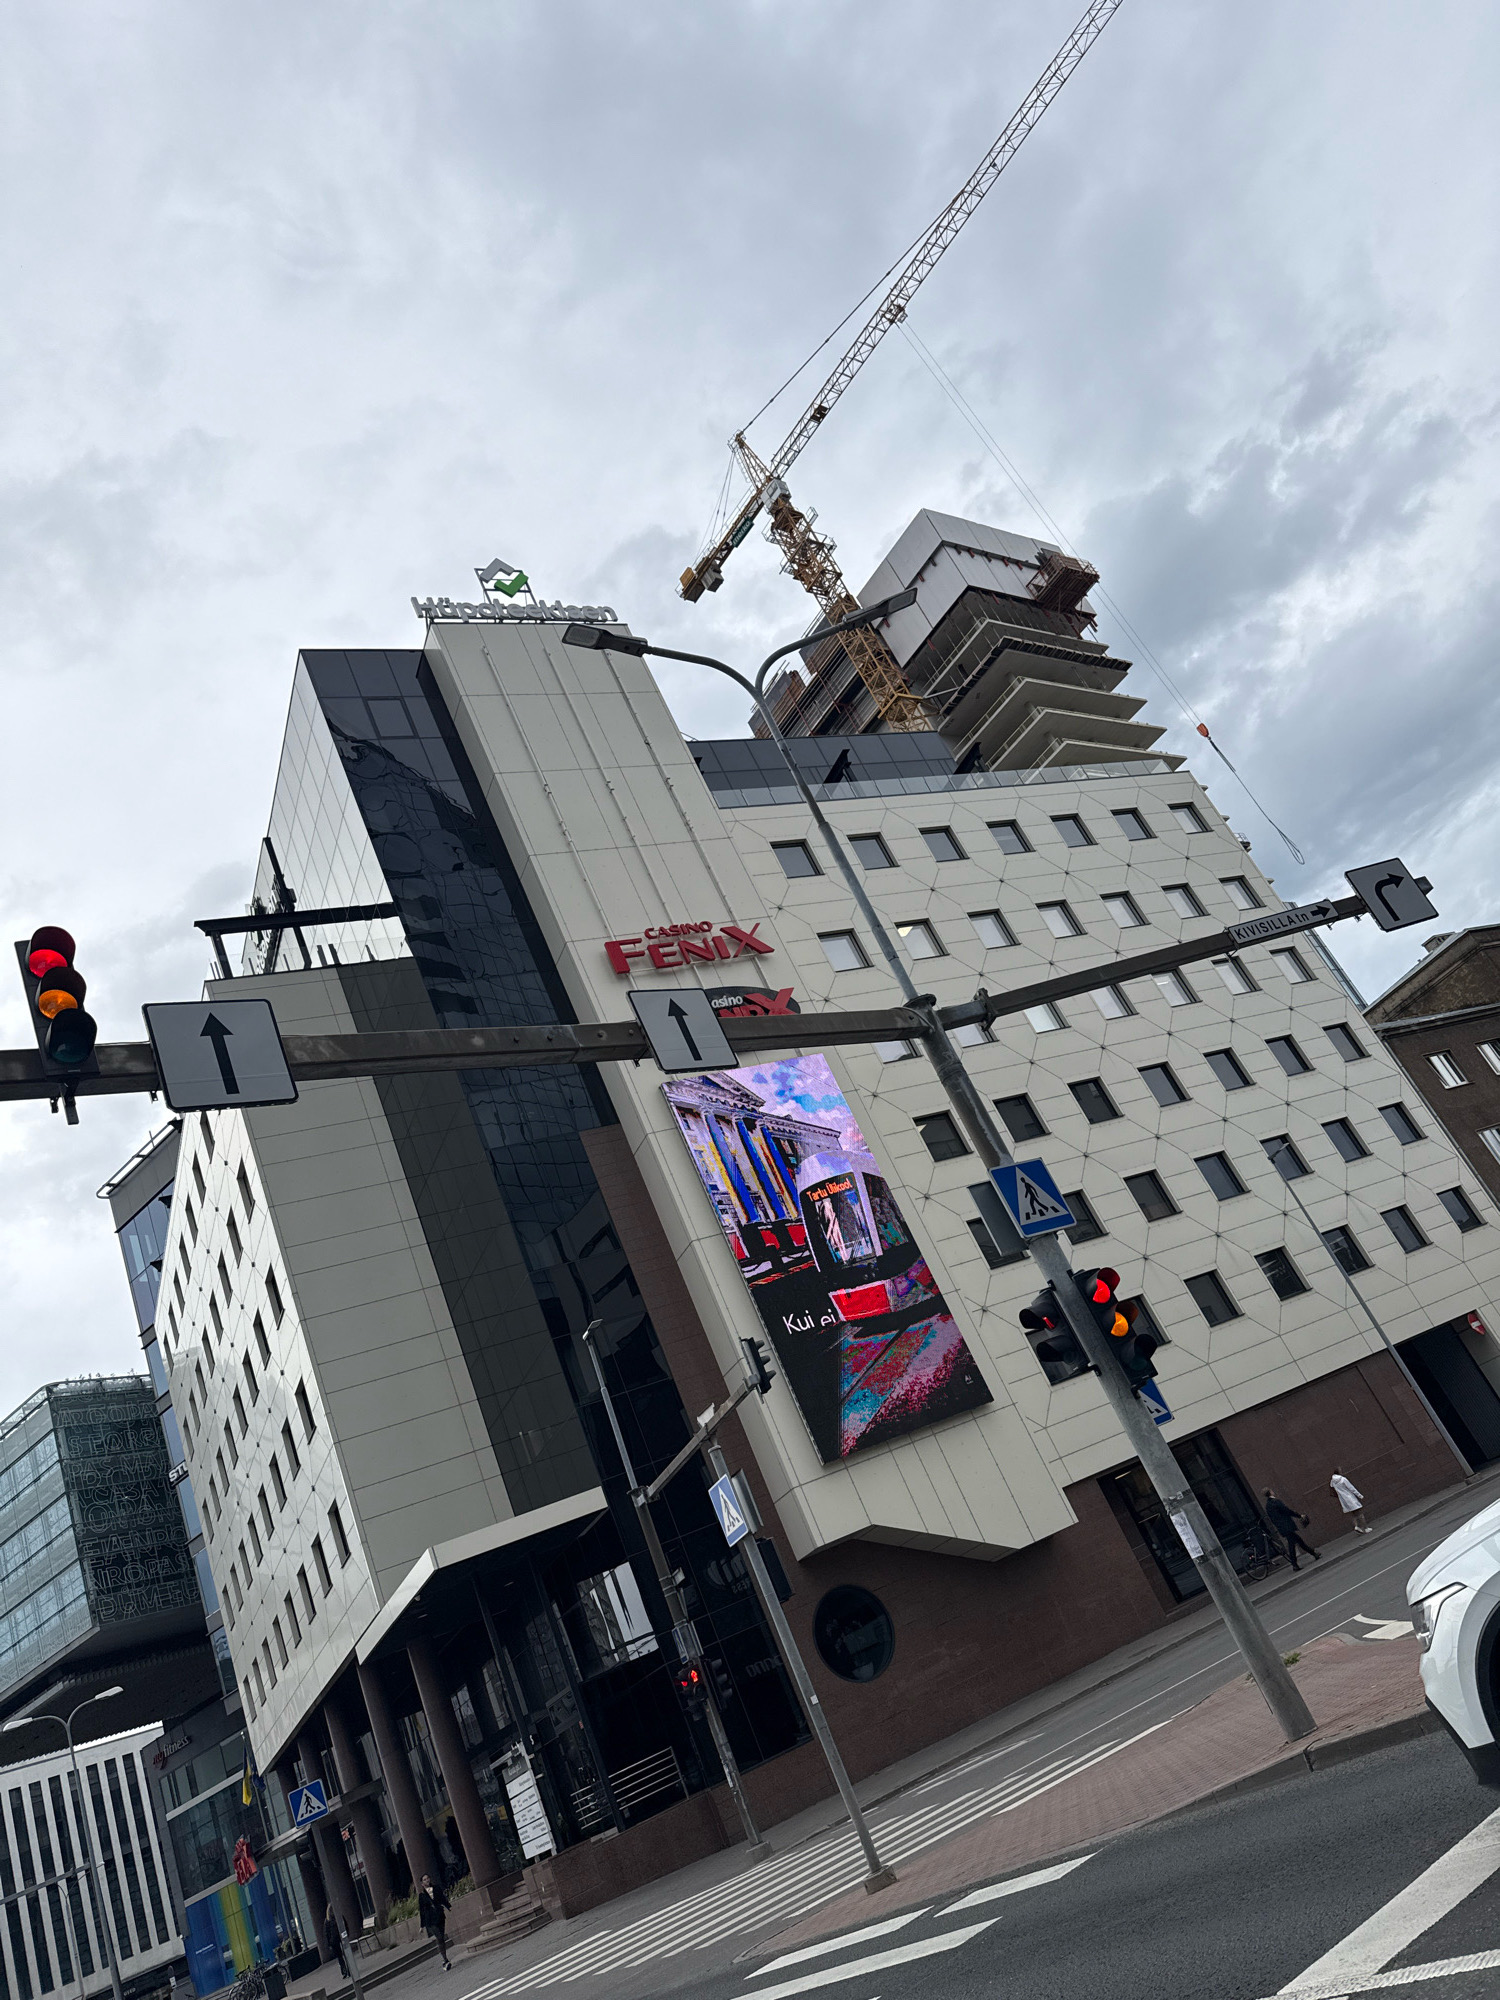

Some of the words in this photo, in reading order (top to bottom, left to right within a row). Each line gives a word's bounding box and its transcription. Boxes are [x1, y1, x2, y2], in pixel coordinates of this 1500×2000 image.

[411, 596, 618, 622] Hüpoteeklaen
[644, 920, 713, 939] CASINO
[1234, 915, 1296, 939] KIVISILLA
[1295, 913, 1309, 923] tn
[604, 922, 775, 974] FENIX
[711, 995, 743, 1008] asino
[806, 1188, 828, 1201] Tartu
[782, 1309, 815, 1335] Kui
[820, 1308, 837, 1327] ei
